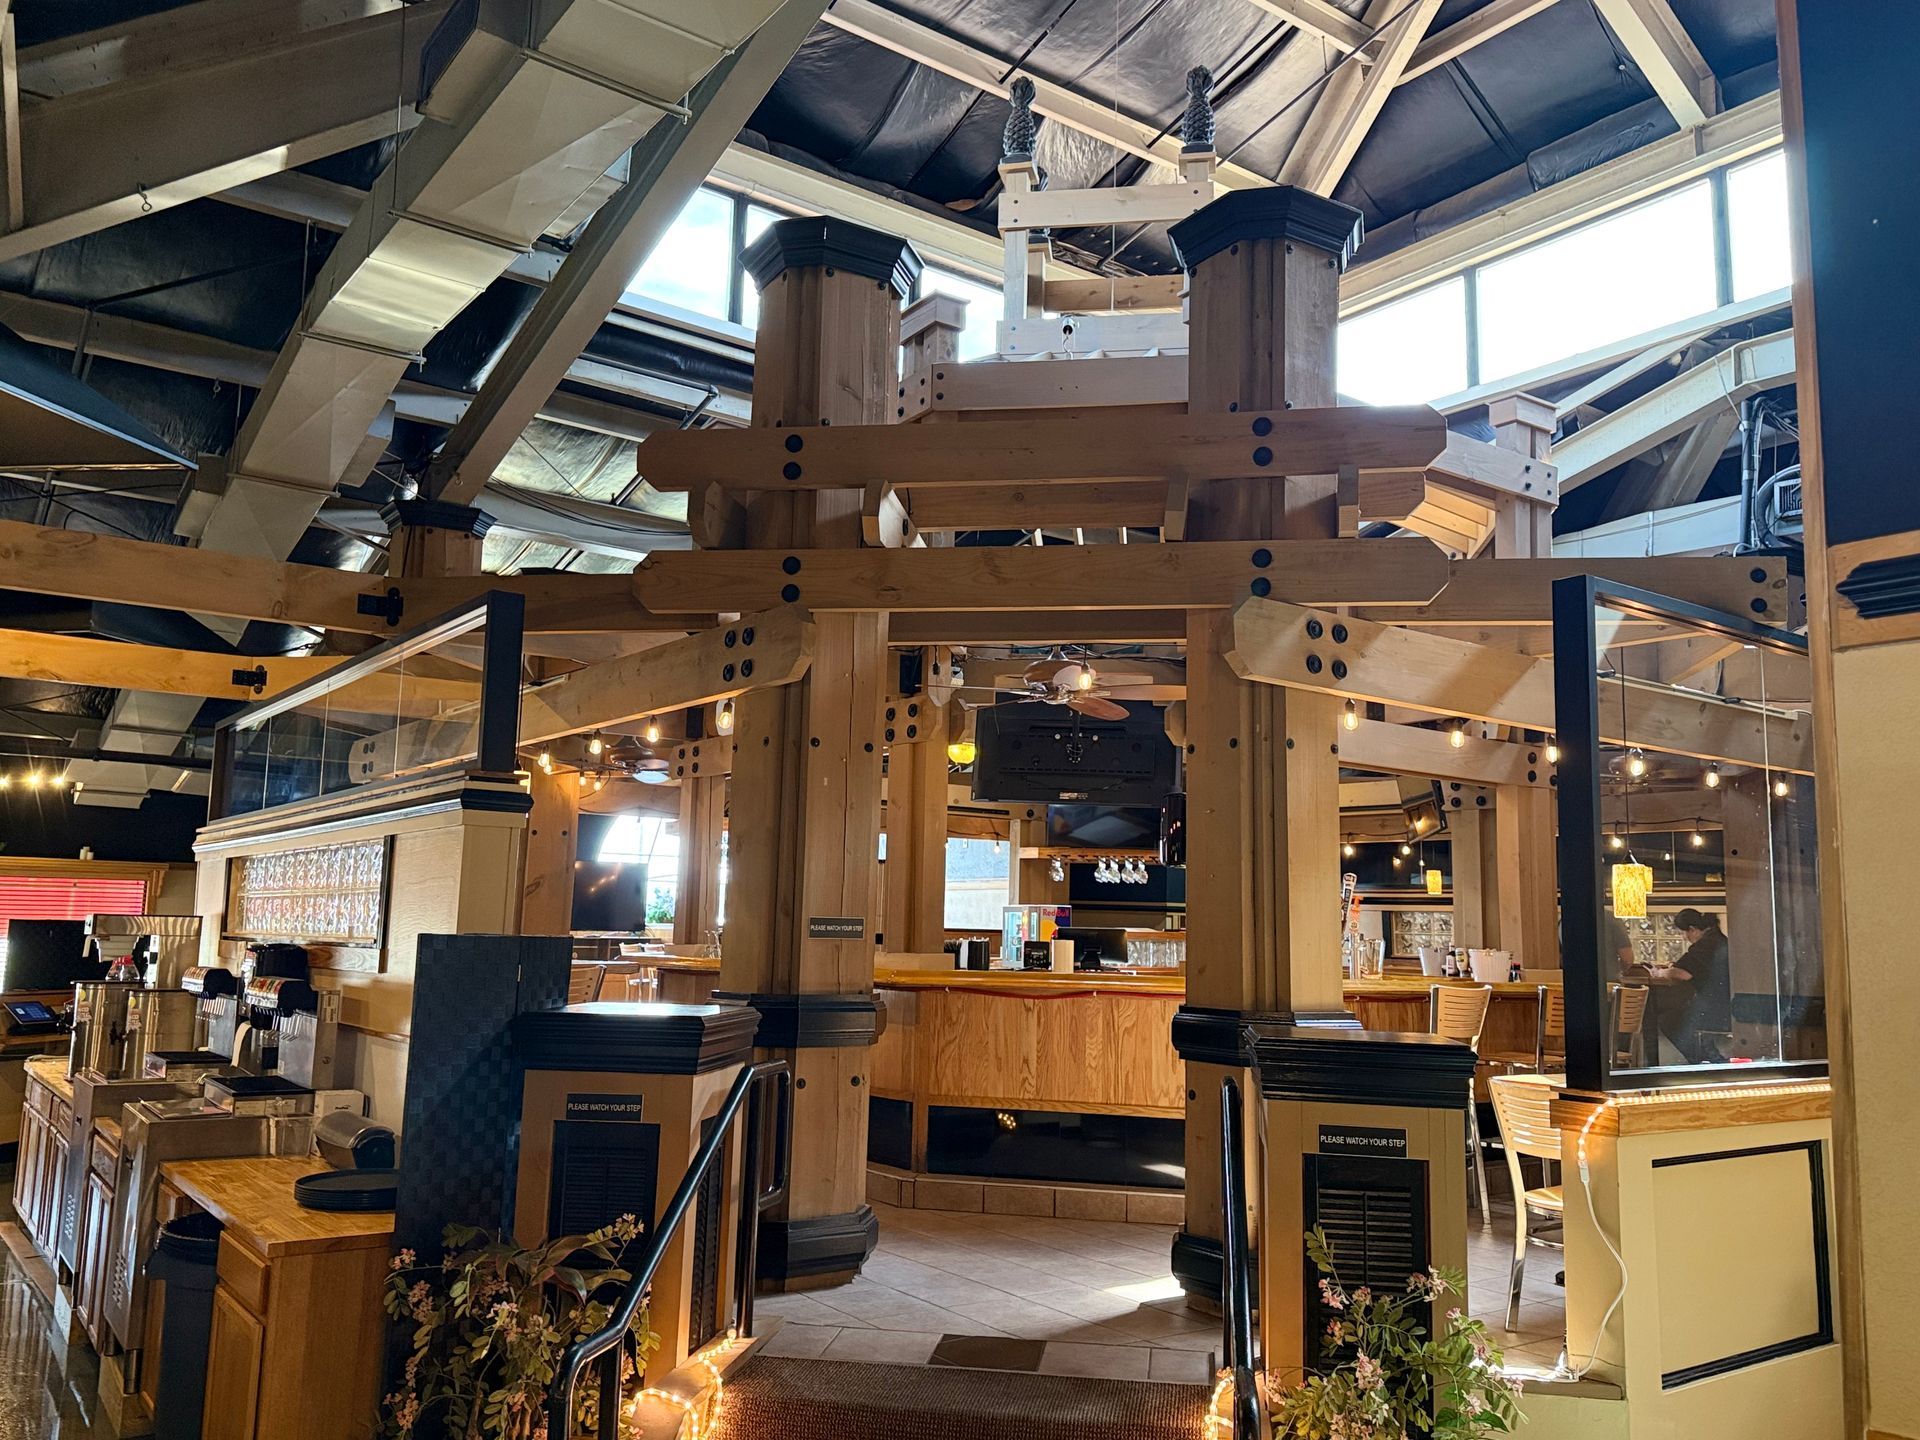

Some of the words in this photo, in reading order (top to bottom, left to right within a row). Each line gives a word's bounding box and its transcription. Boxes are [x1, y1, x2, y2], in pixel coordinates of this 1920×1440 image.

[1043, 908, 1055, 917] Red
[568, 1103, 589, 1111] PLEASE
[610, 1104, 625, 1112] YOUR
[1320, 1135, 1344, 1144] PLEASE
[1345, 1136, 1368, 1145] WATCH
[1369, 1138, 1387, 1147] YOUR
[1388, 1139, 1405, 1147] STEP
